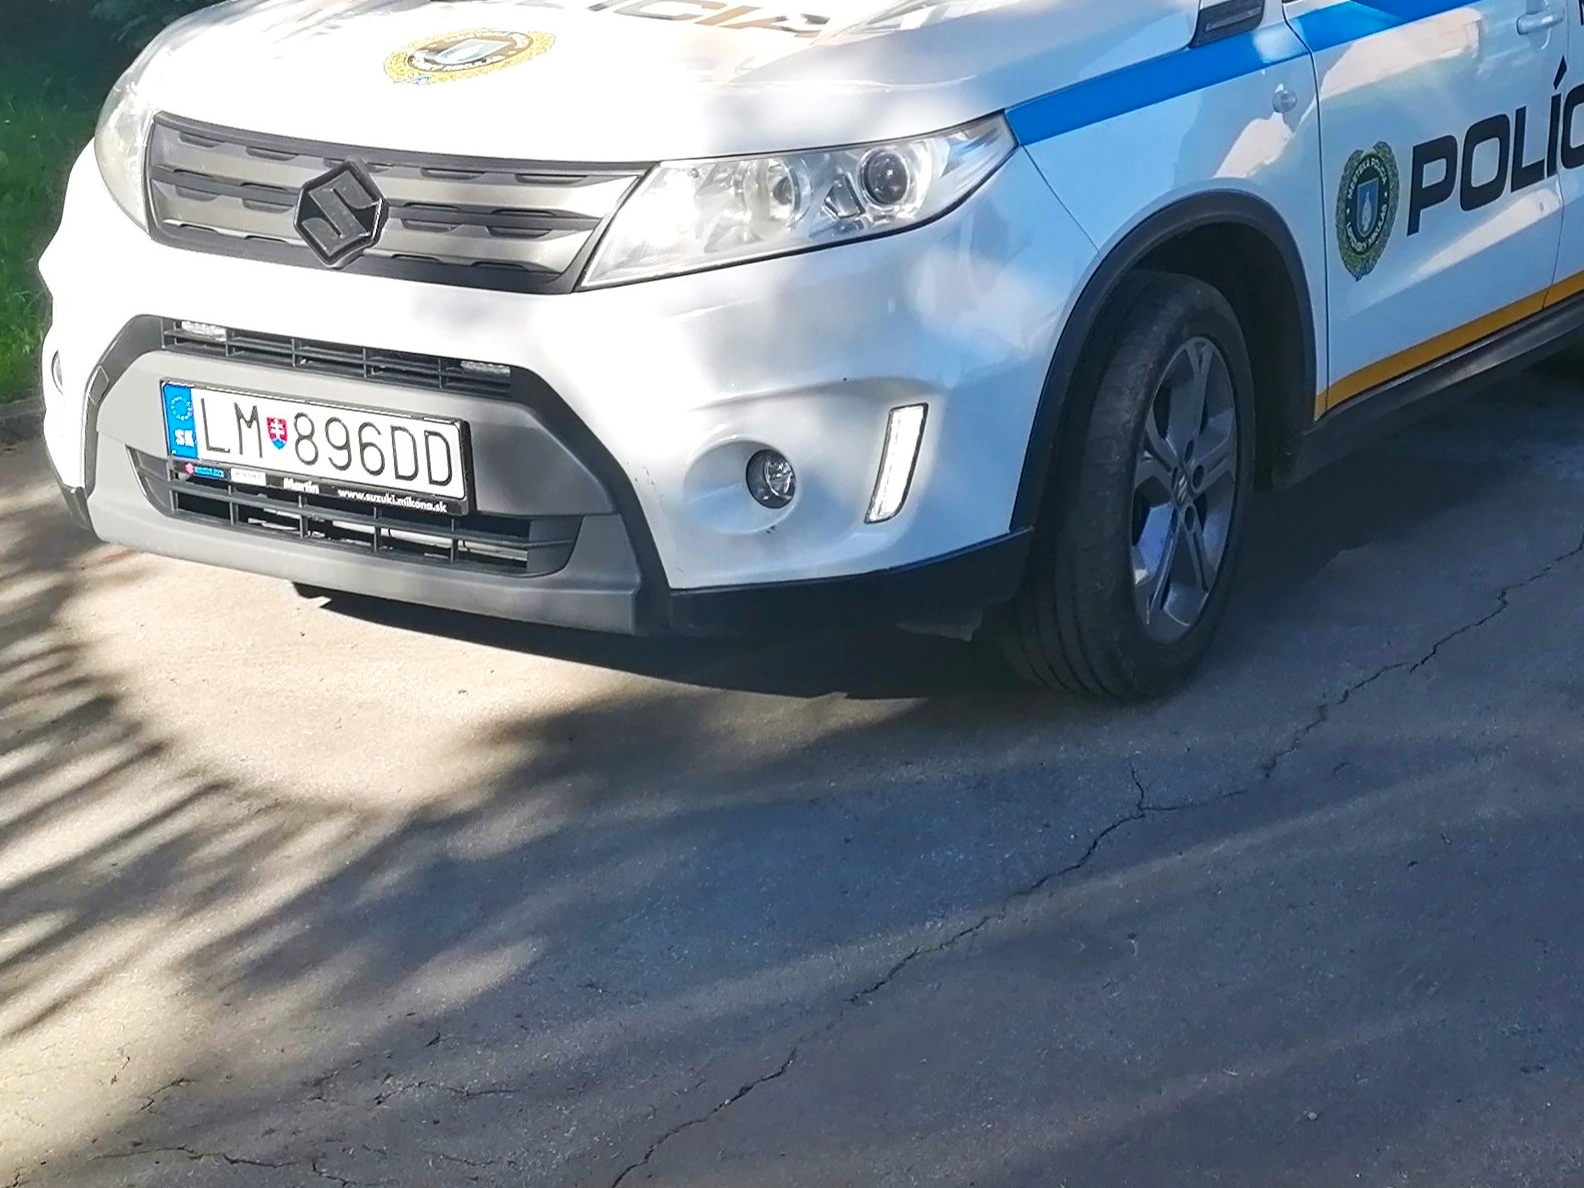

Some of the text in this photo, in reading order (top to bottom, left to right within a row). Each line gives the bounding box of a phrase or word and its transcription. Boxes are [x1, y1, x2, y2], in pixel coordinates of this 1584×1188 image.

[174, 428, 195, 448] SK
[200, 397, 453, 487] LM 896DD
[283, 477, 320, 494] Martin
